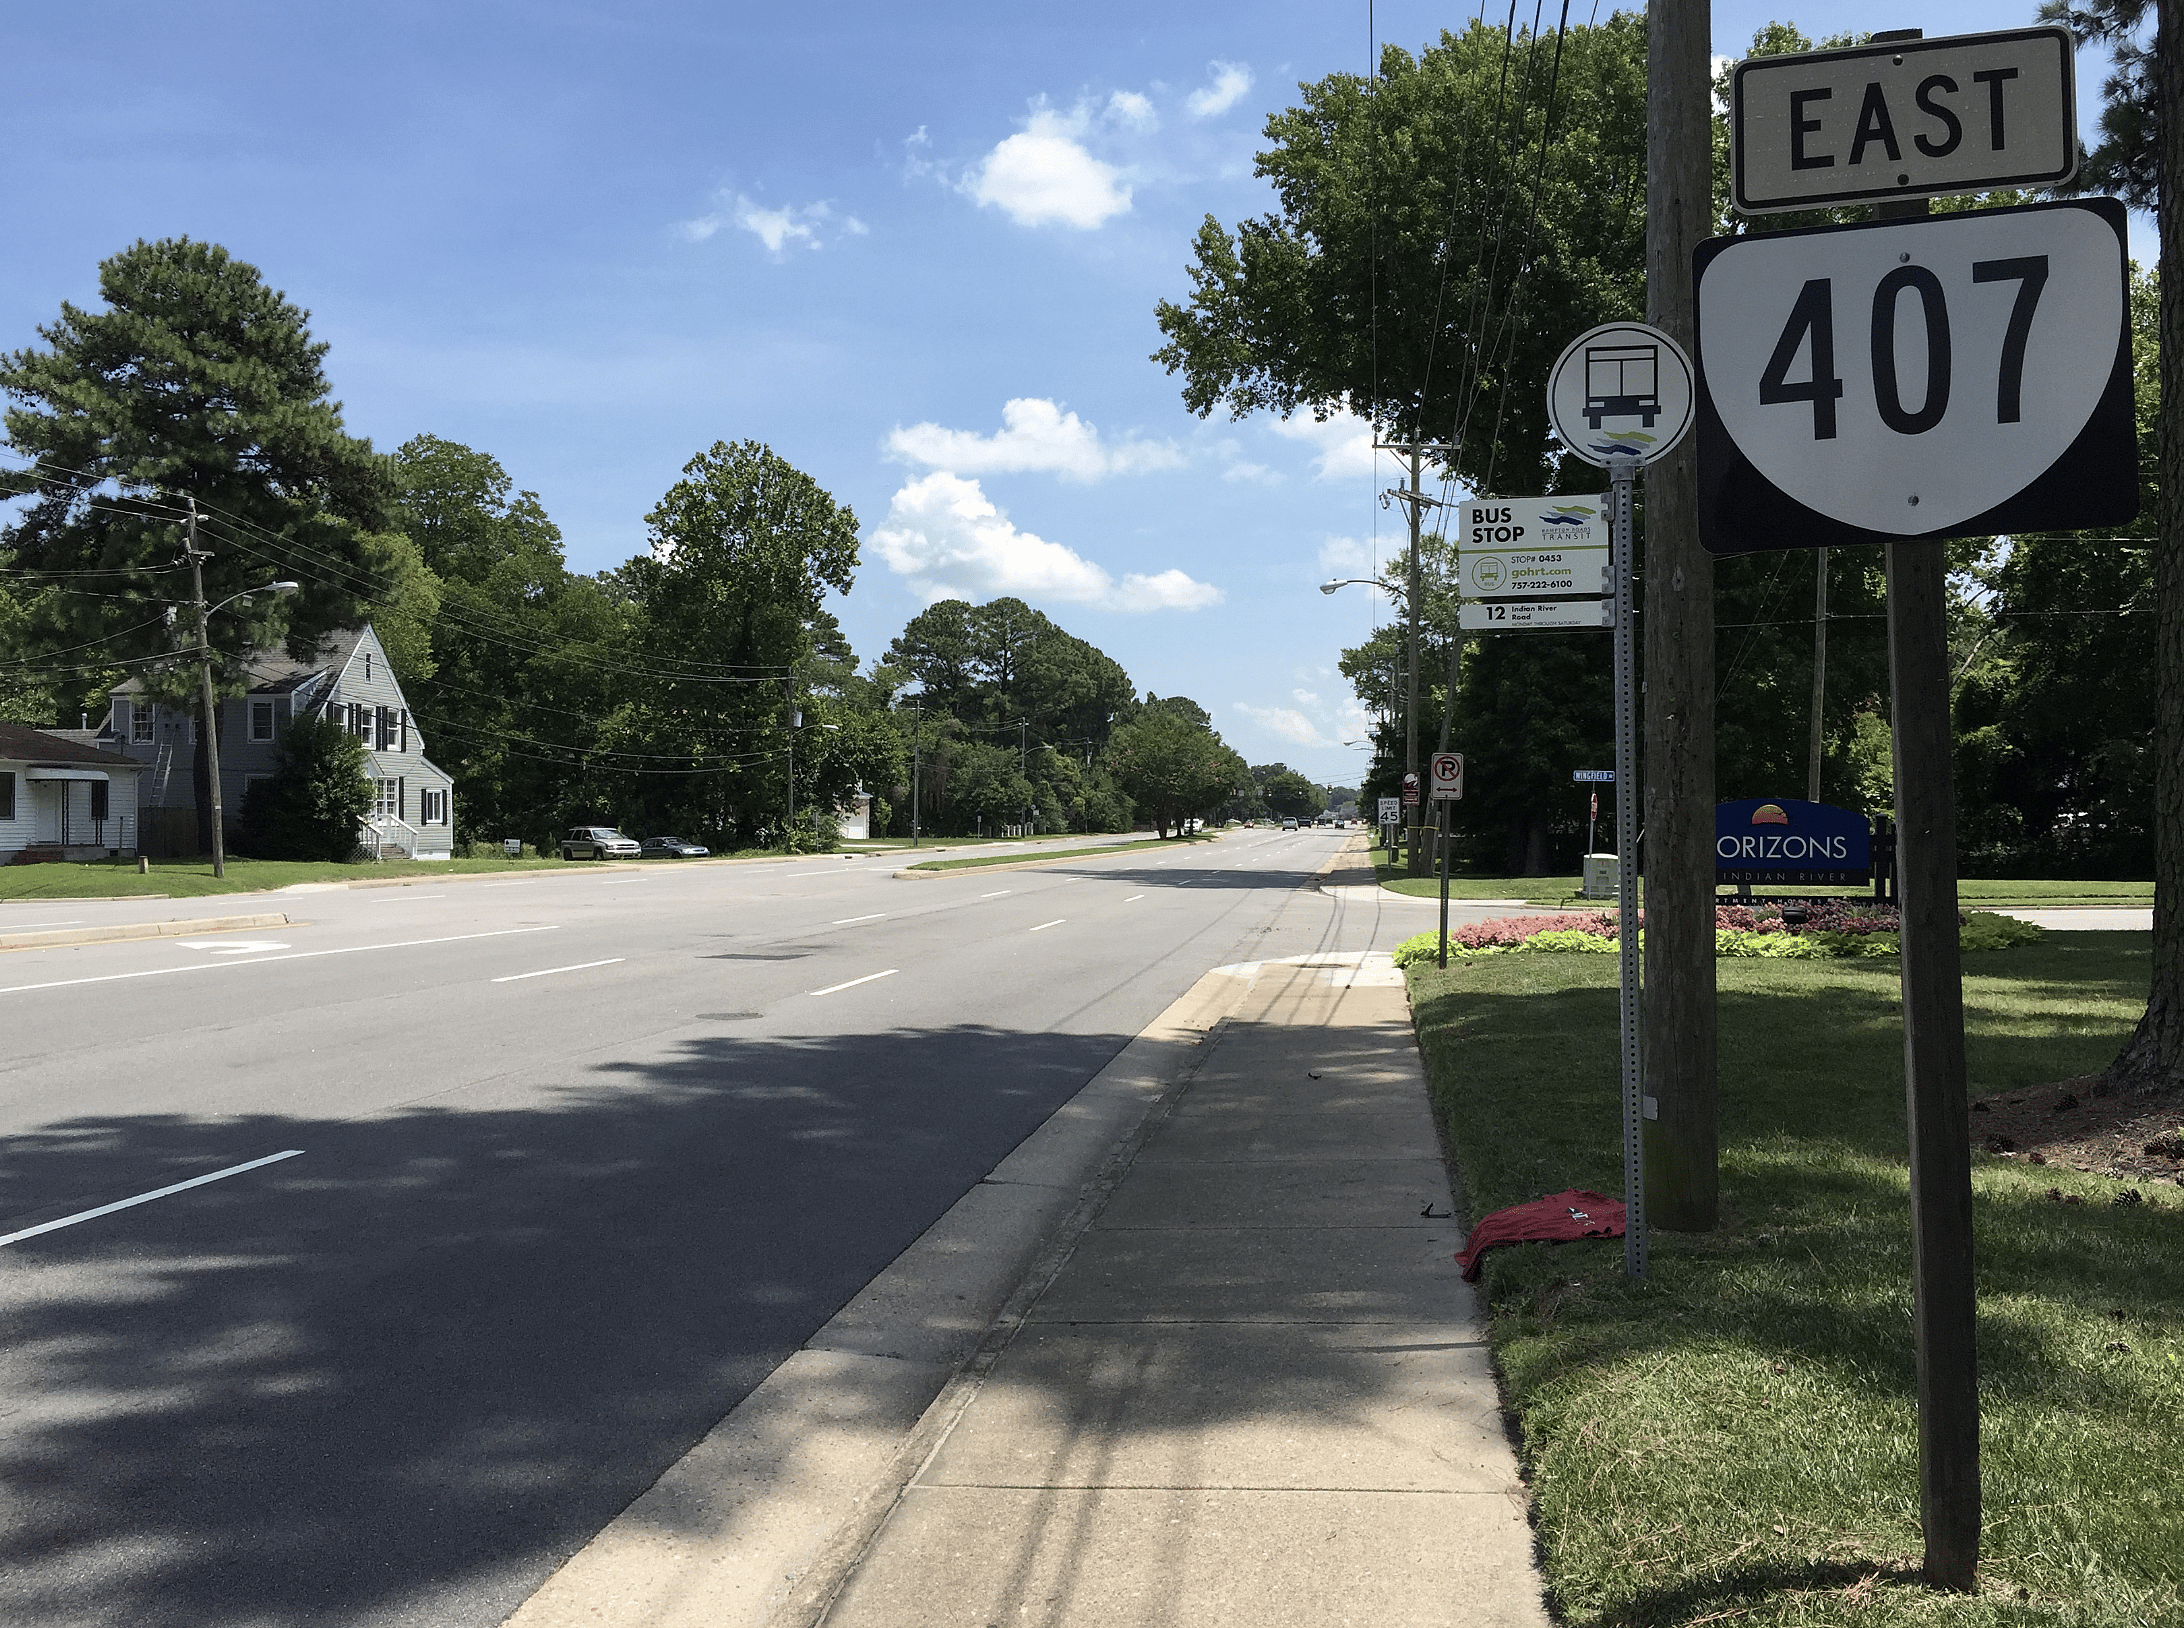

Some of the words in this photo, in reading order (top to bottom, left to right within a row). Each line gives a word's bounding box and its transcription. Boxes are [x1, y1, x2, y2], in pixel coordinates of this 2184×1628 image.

[1789, 67, 2019, 171] EAST
[1758, 254, 2049, 441] 407
[1472, 507, 1512, 524] BUS
[1472, 526, 1525, 543] STOP
[1542, 532, 1591, 541] TRANSIT
[1511, 555, 1536, 564] STOP#
[1538, 554, 1562, 563] 0453
[1511, 567, 1572, 579] gohrt.com
[1511, 580, 1573, 590] 757-222-6100
[1486, 606, 1506, 620] 12
[1511, 605, 1536, 613] Indian
[1511, 613, 1532, 621] Road
[1380, 811, 1398, 821] 45
[1716, 835, 1848, 859] ORIZONS
[1723, 872, 1786, 881] INDIAN
[1799, 872, 1846, 881] RIVER
